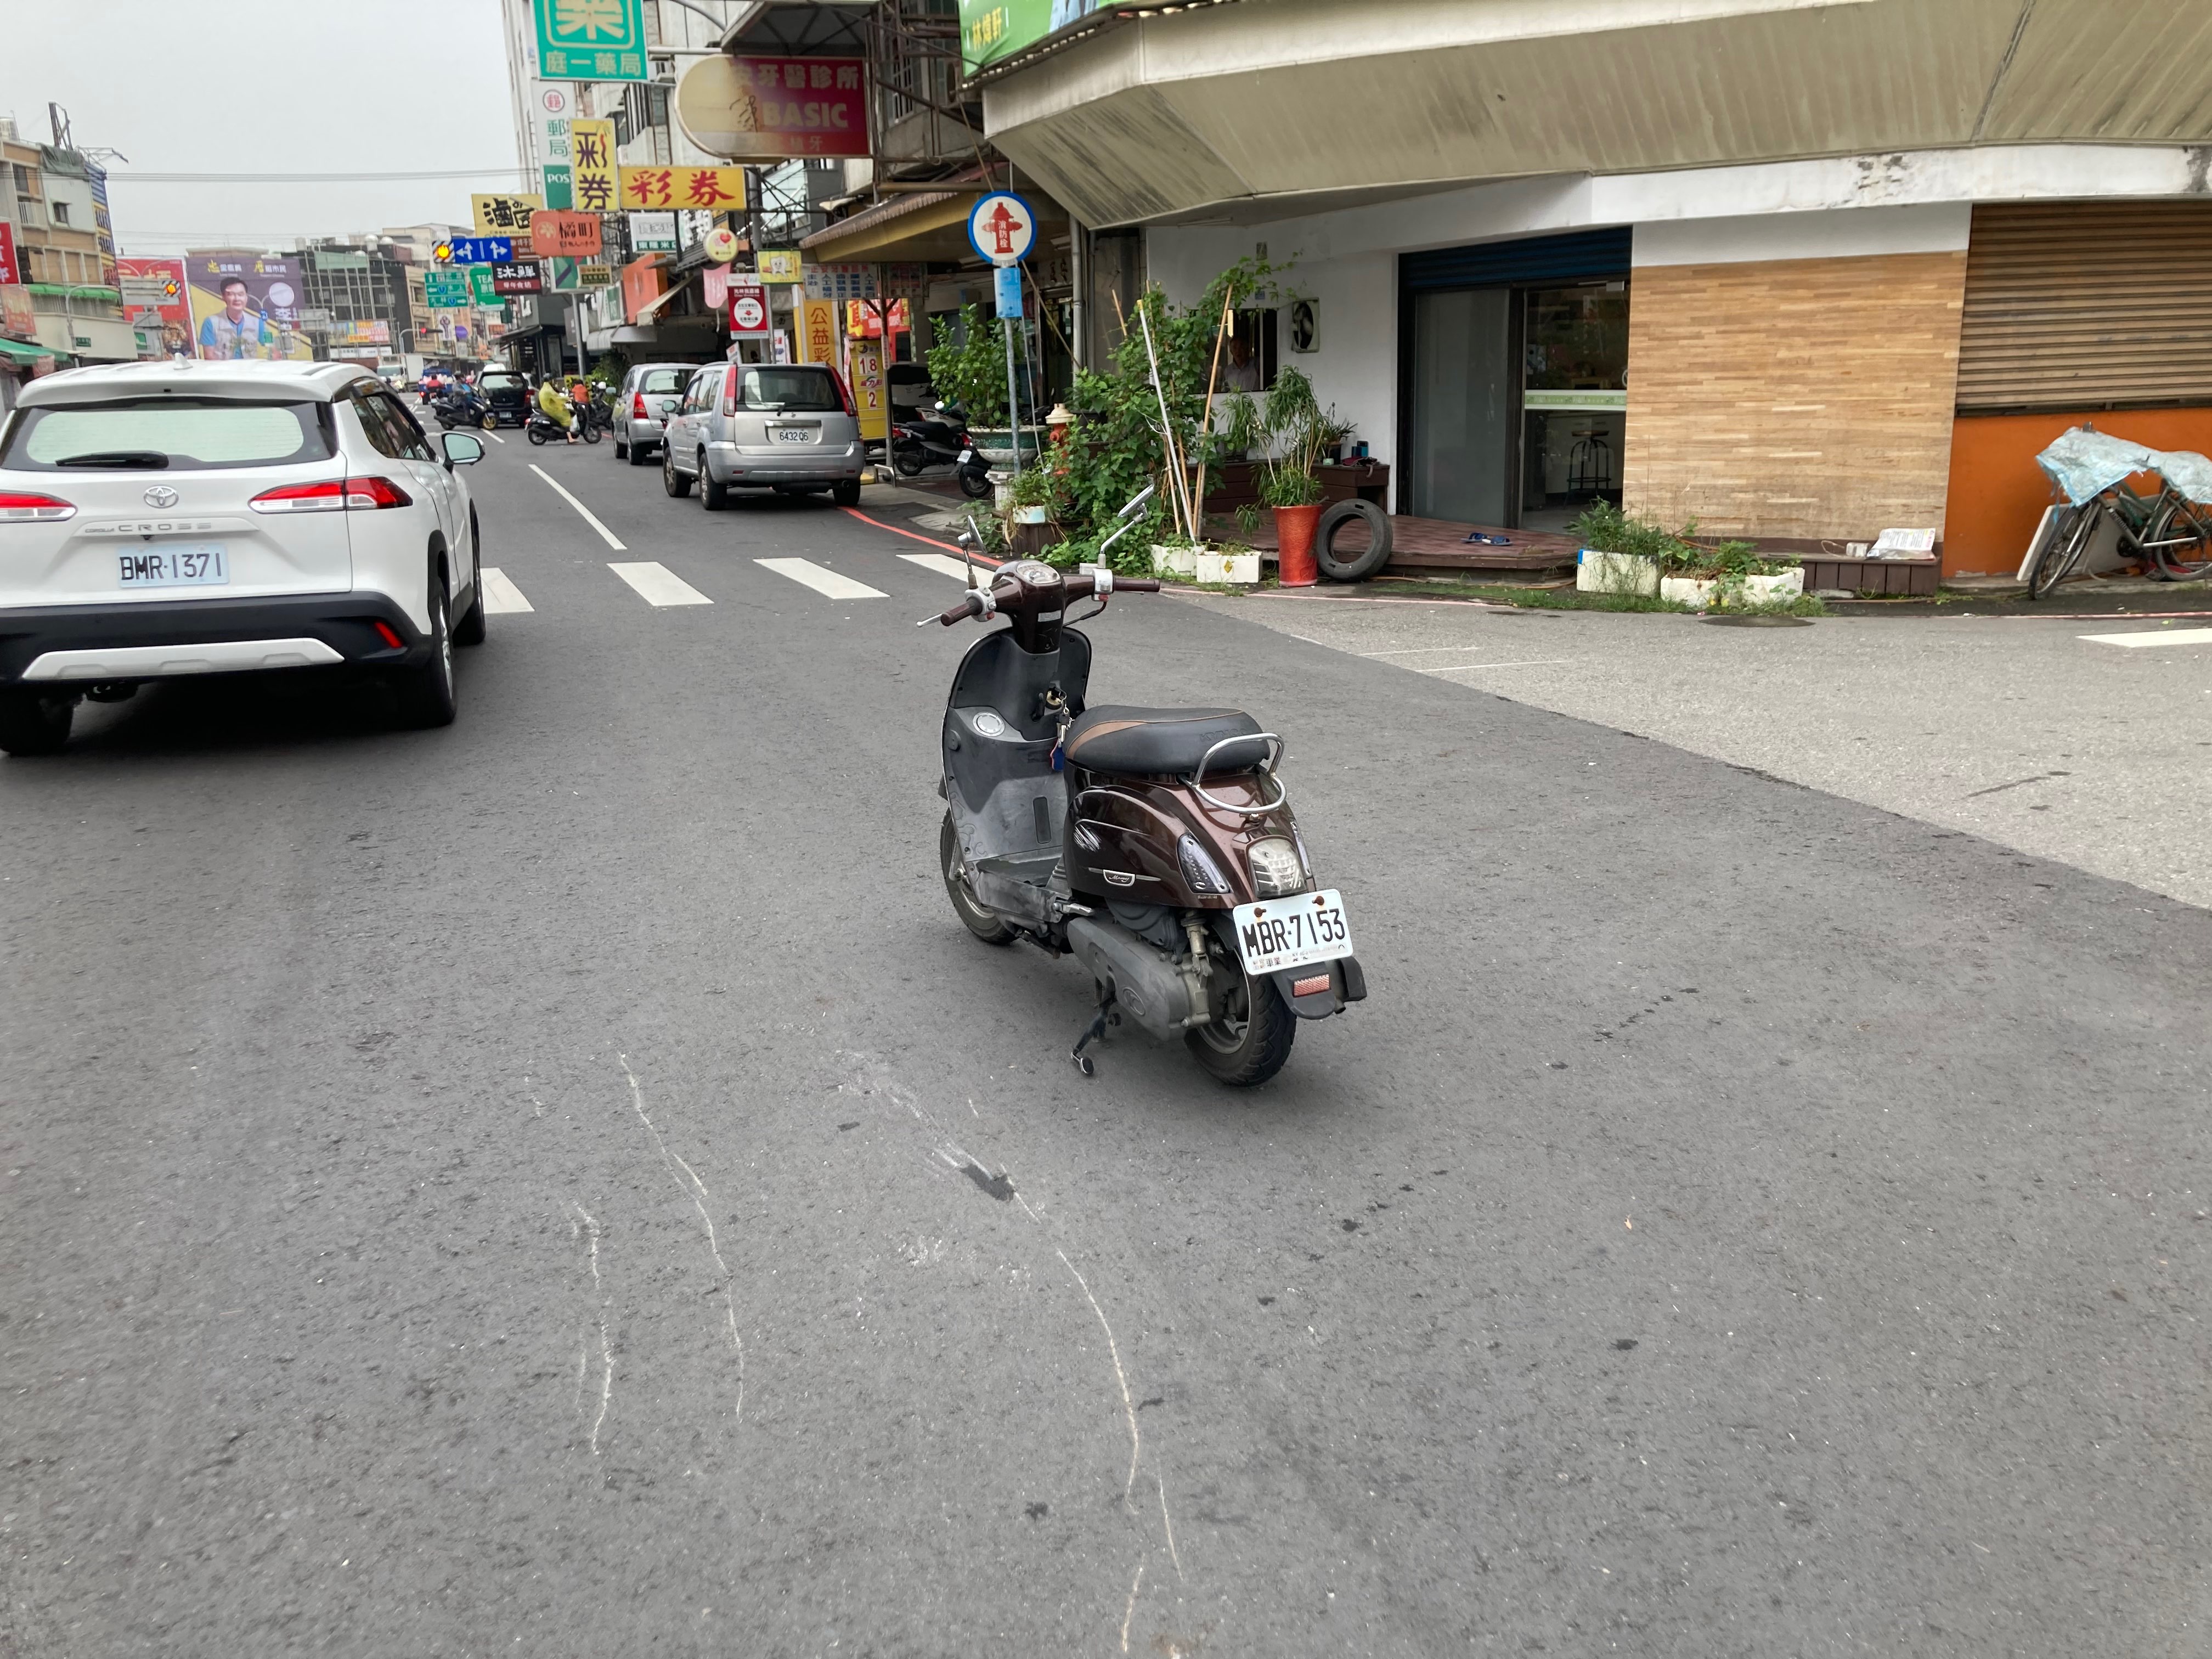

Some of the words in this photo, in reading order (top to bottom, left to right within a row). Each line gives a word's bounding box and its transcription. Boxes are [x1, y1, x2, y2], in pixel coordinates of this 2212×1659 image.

[546, 50, 641, 76] 庭一藥局
[762, 102, 848, 128] BASIC
[547, 119, 568, 157] 郵局
[547, 173, 571, 184] POS
[575, 131, 613, 210] 彩券
[628, 170, 736, 206] 彩券
[998, 221, 1008, 248] 消防栓
[869, 392, 876, 407] 2
[119, 522, 211, 532] CROSS
[120, 553, 222, 580] BMR-1371
[1242, 908, 1345, 957] MBR-7153
